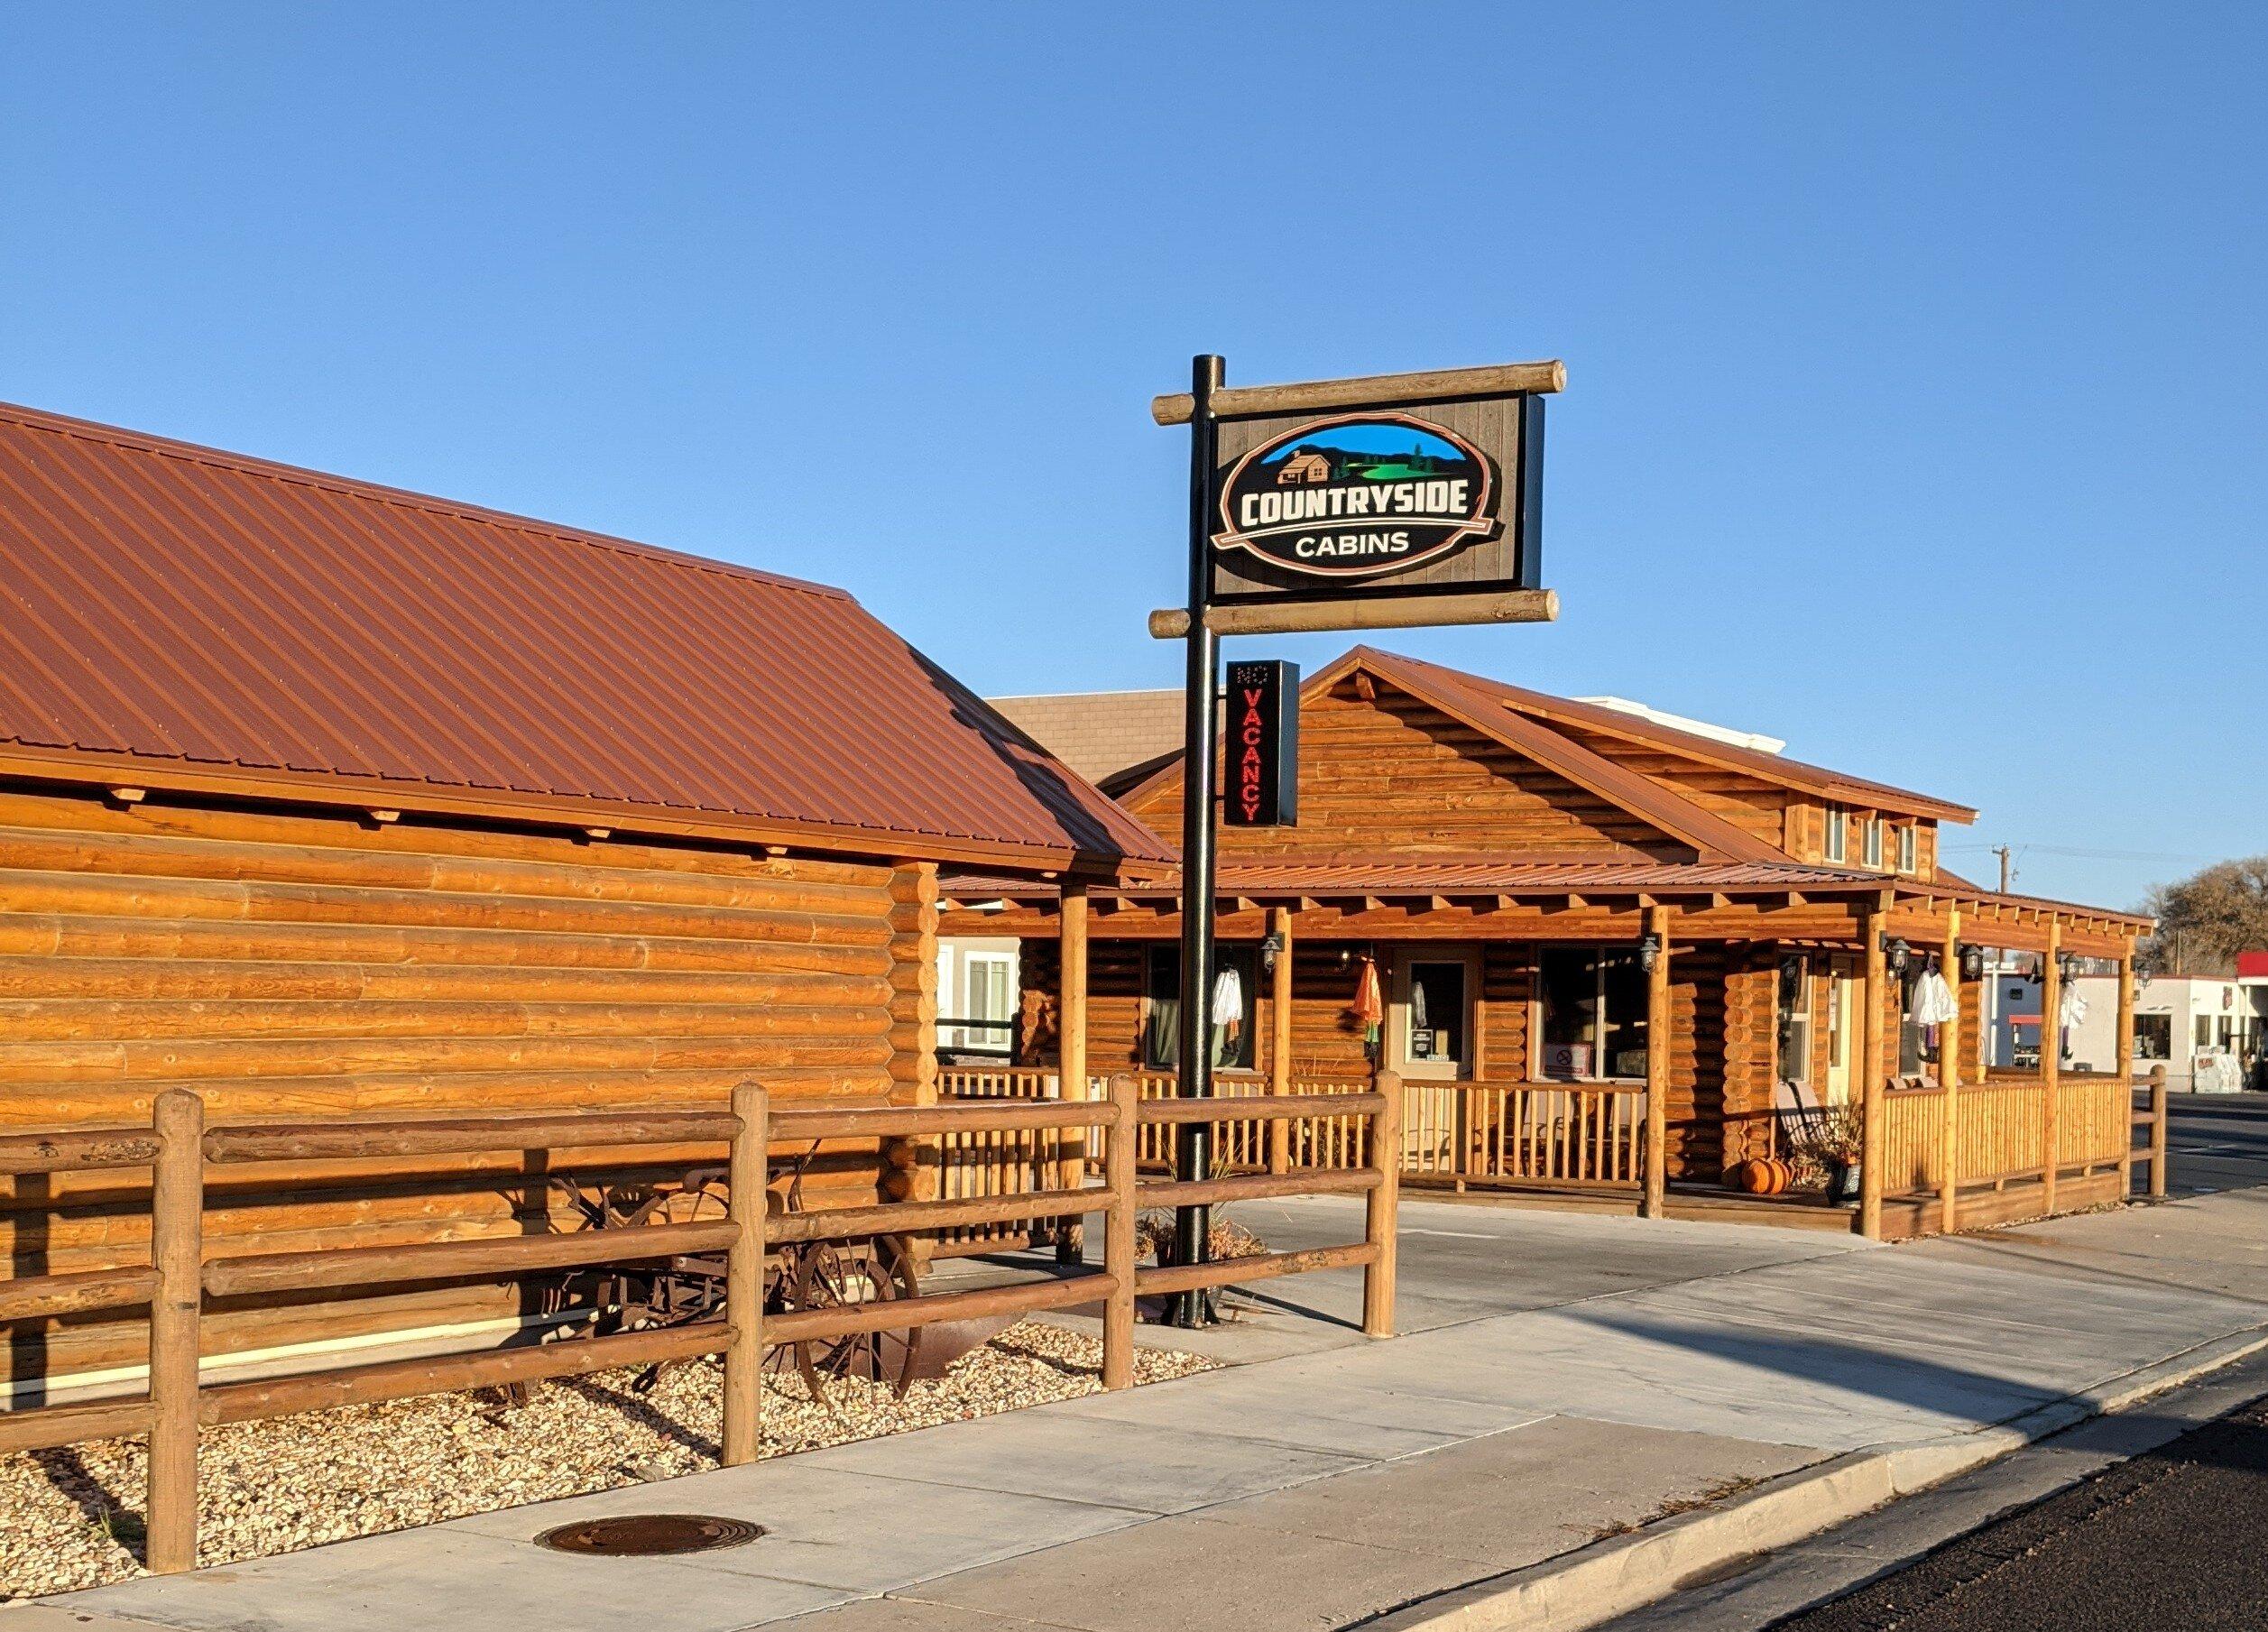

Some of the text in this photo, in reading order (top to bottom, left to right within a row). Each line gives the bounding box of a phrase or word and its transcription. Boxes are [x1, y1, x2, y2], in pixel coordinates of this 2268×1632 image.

[1241, 479, 1469, 527] COUNTRYSIDE
[1295, 532, 1409, 558] CABINS
[1237, 666, 1268, 685] NO
[1241, 688, 1262, 821] VACANCY
